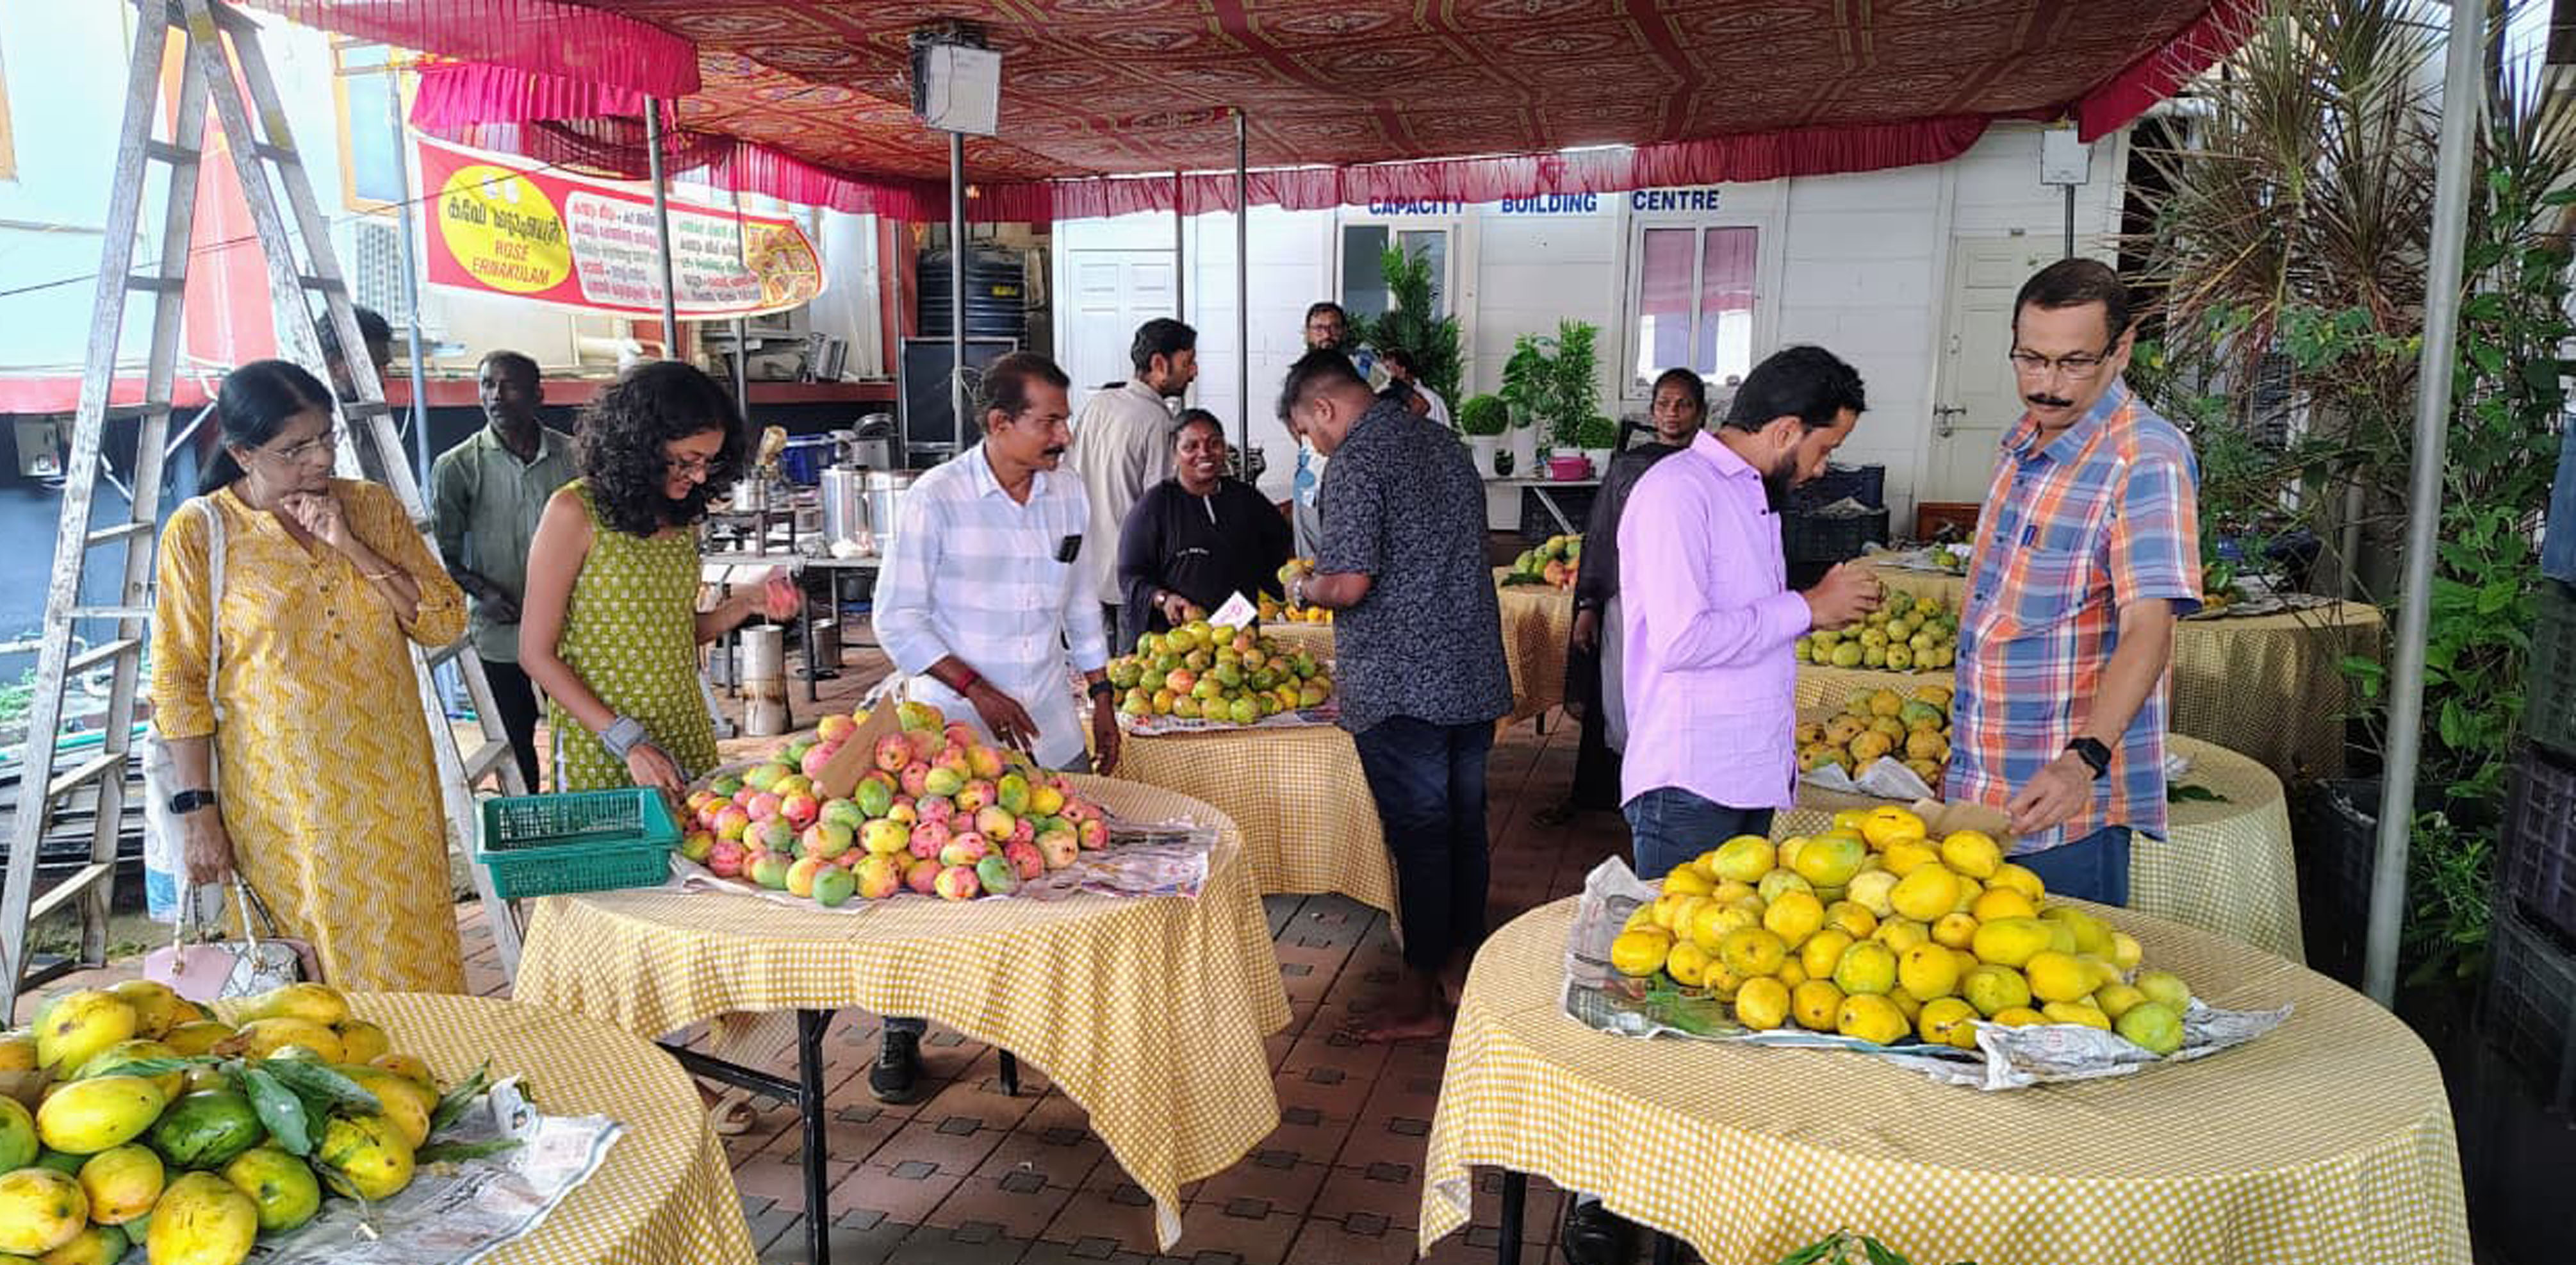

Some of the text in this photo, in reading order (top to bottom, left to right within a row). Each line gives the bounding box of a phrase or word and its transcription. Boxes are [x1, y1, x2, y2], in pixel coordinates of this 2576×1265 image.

[1368, 190, 1720, 215] CAPACITY BUILDING CENTRE
[495, 239, 529, 261] ROSE
[472, 256, 550, 284] ERNAKULAM
